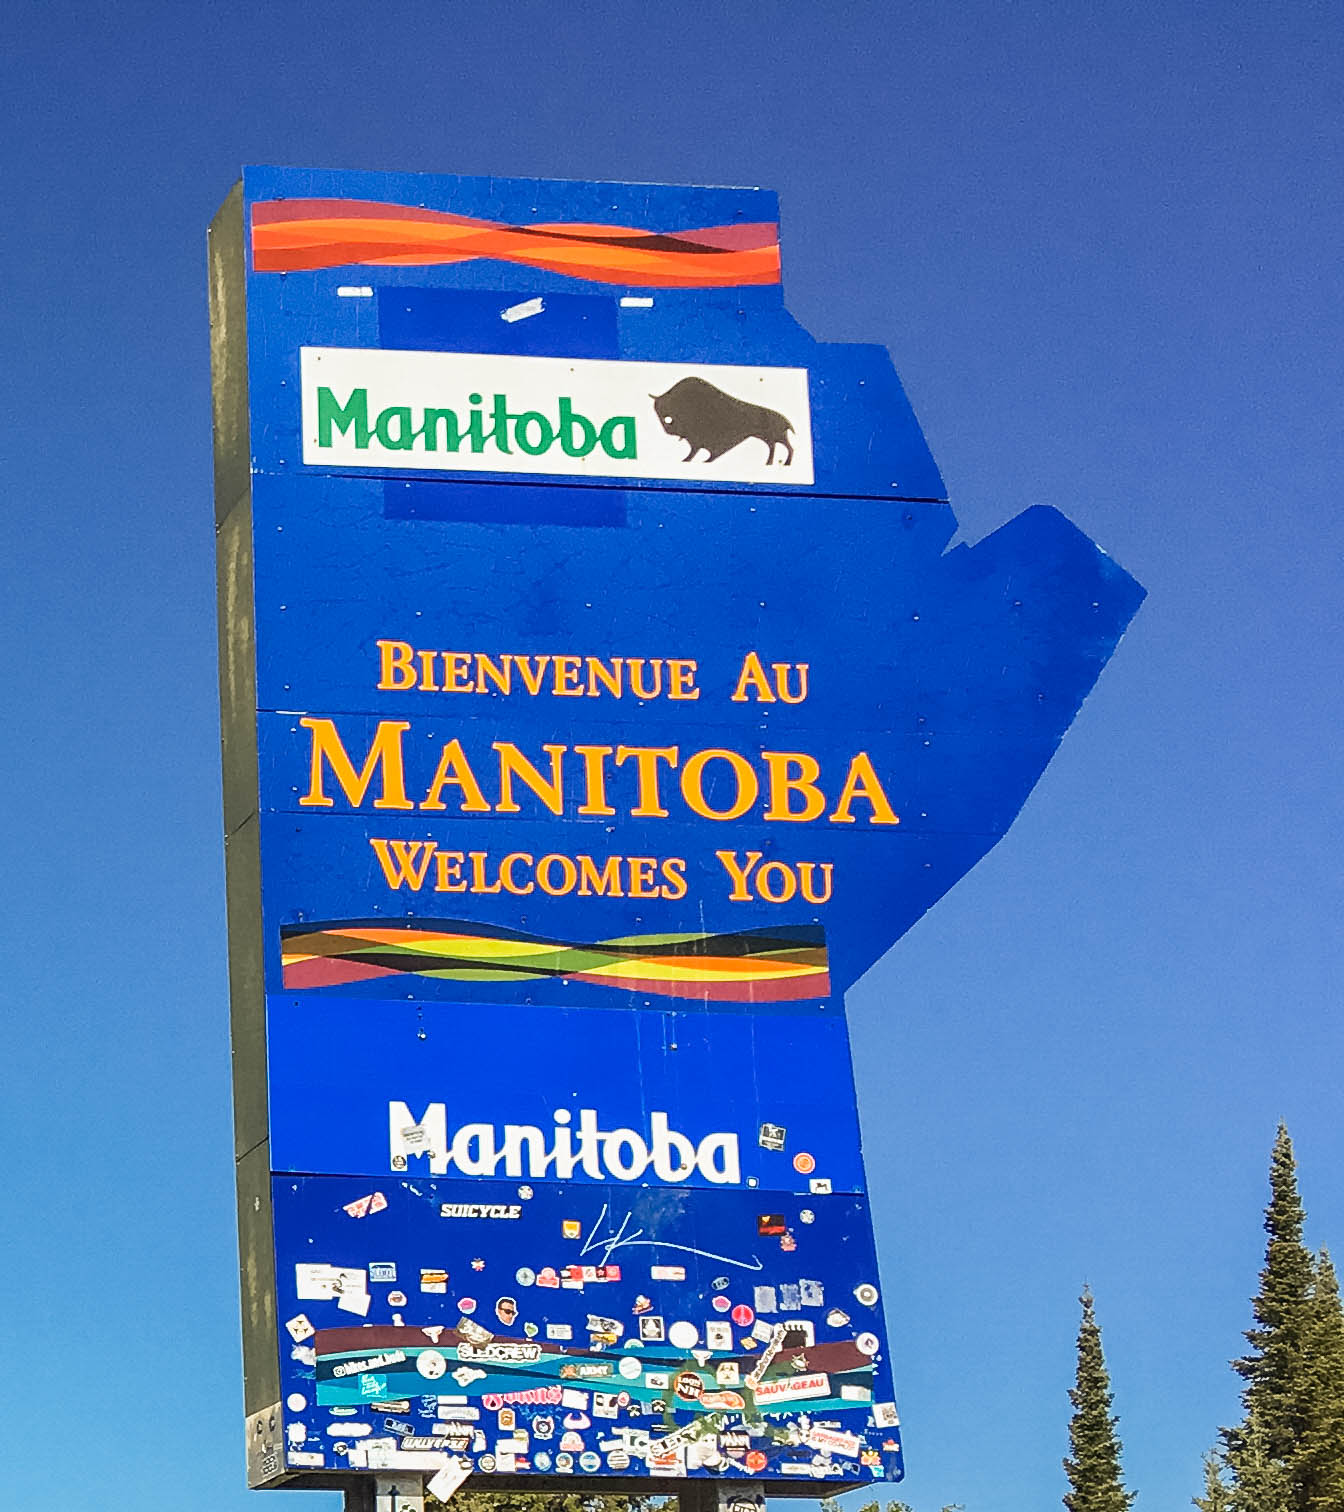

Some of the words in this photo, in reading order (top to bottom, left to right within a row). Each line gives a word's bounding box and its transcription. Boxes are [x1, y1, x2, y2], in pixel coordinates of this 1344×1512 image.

[318, 386, 638, 460] Manitoba
[376, 640, 700, 701] BIENVENUE
[298, 717, 900, 825] MANITOBA
[370, 838, 688, 900] WELCOMES
[716, 850, 834, 904] YOU
[389, 1101, 742, 1184] Manitoba
[439, 1203, 522, 1220] SUICYCLE
[677, 1382, 701, 1398] NH
[755, 1378, 825, 1396] SAUVGEAU
